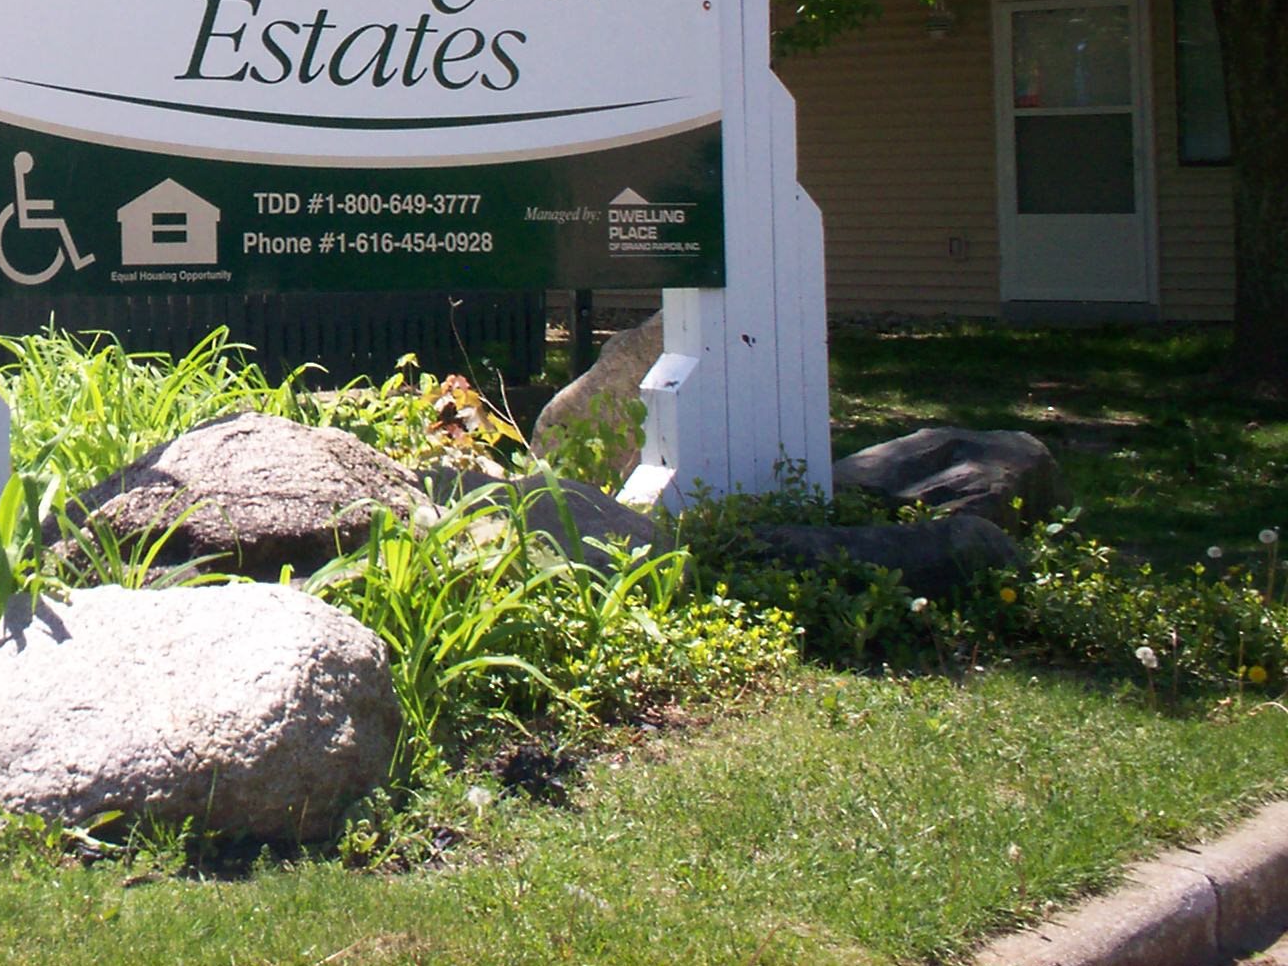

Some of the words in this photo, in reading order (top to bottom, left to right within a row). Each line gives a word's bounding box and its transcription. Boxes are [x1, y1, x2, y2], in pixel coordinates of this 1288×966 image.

[253, 192, 301, 215] TDD
[306, 193, 482, 216] #1-800-649-3777
[524, 206, 580, 224] Managed
[581, 206, 602, 225] by:
[608, 209, 686, 224] DWELLING
[608, 226, 658, 240] PLACE
[242, 232, 312, 254] Phone
[318, 232, 493, 256] #1-616-454-0928
[110, 271, 137, 283] Equal
[139, 270, 177, 282] Housing
[179, 269, 232, 282] Opportunity
